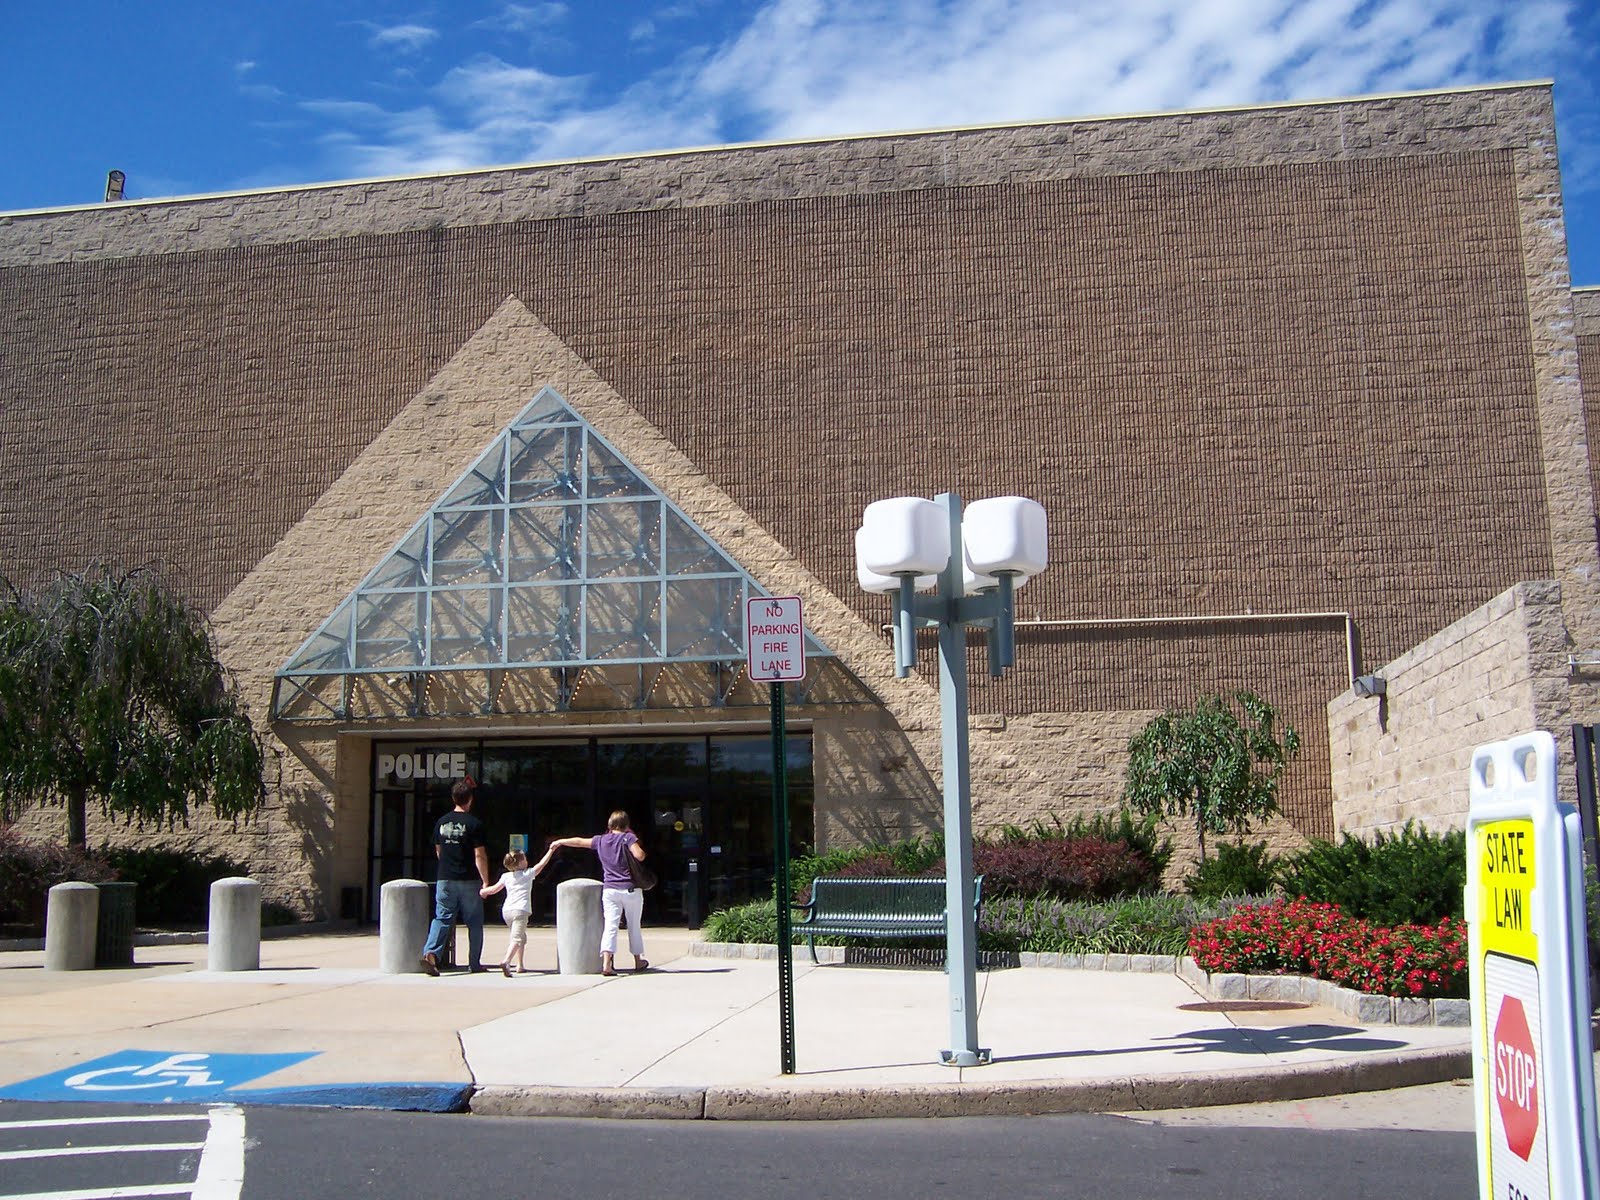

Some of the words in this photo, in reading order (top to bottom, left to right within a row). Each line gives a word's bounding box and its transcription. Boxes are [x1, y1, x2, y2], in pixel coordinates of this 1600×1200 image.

[766, 606, 783, 617] NO
[751, 623, 799, 636] PARKING
[763, 642, 788, 653] FIRE
[761, 660, 791, 671] LANE
[378, 753, 466, 779] POLICE
[1486, 831, 1527, 874] STATE
[1494, 887, 1522, 931] LAW
[1496, 1040, 1535, 1112] STOP
